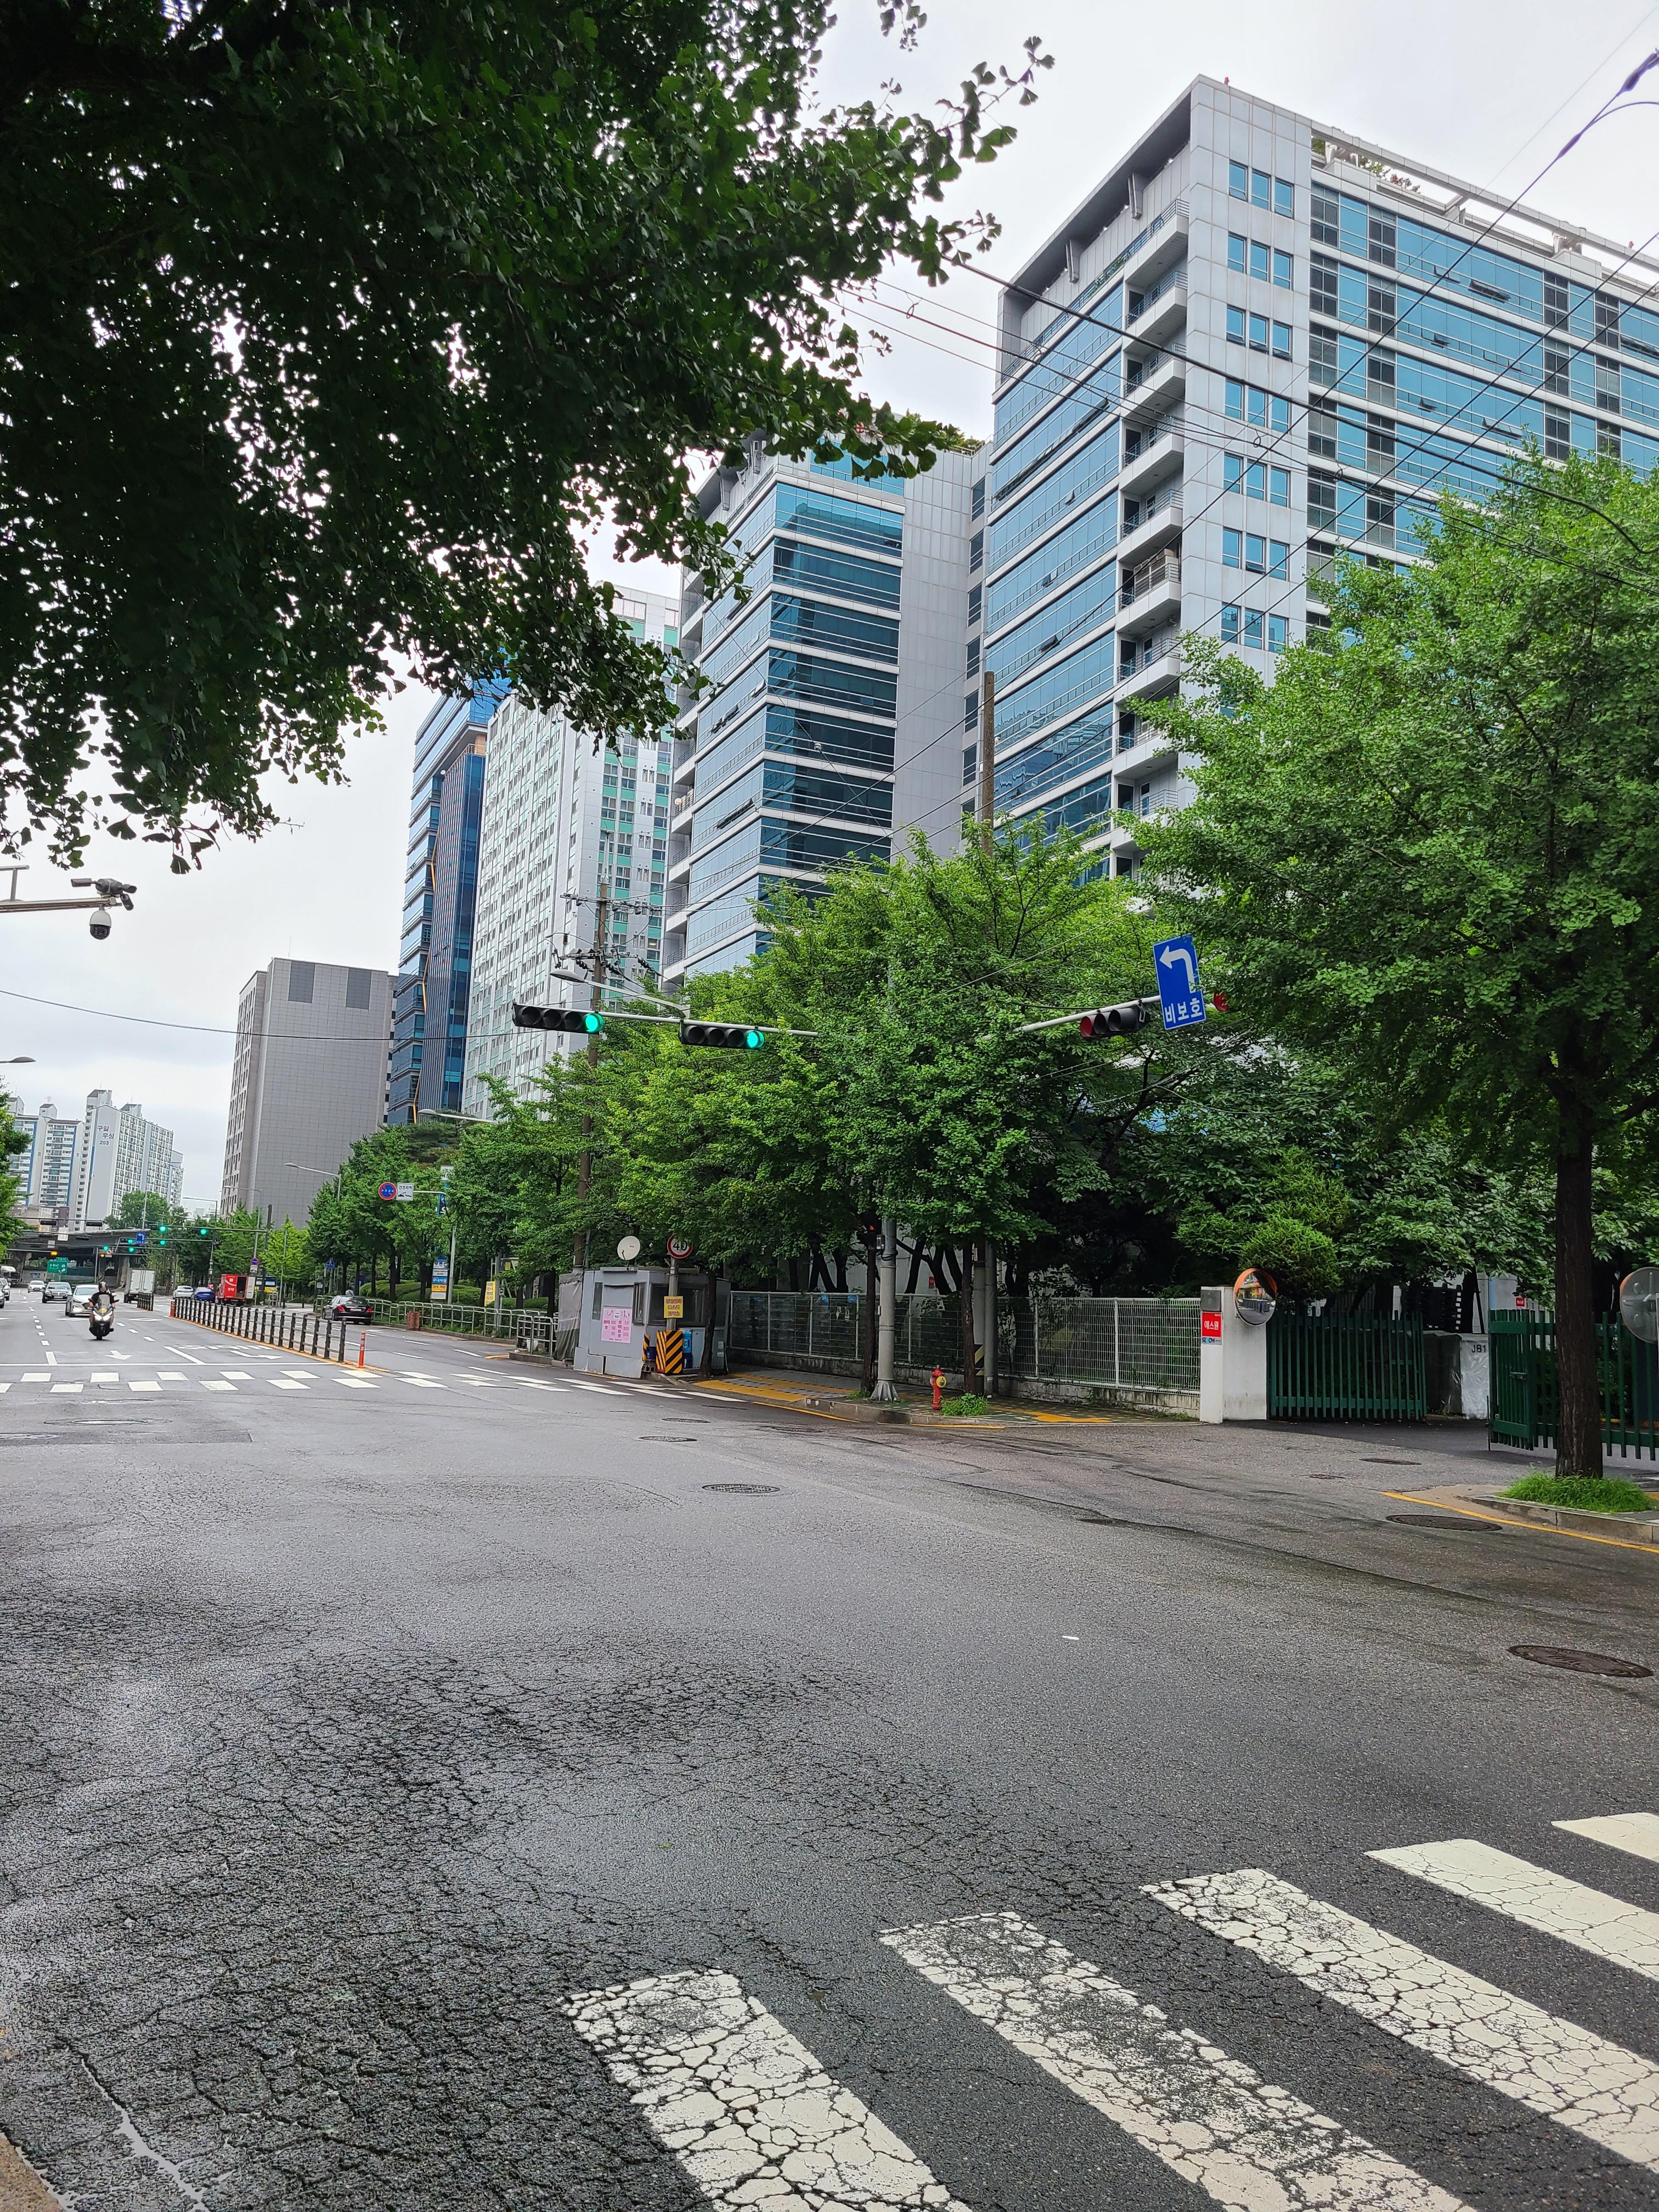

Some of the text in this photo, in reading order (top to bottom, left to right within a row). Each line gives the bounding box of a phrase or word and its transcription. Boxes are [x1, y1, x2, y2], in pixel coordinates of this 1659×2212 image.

[1164, 997, 1203, 1024] 비보호
[673, 1241, 687, 1251] 40
[1204, 1321, 1219, 1330] 에스원
[1471, 1344, 1486, 1353] JB1
